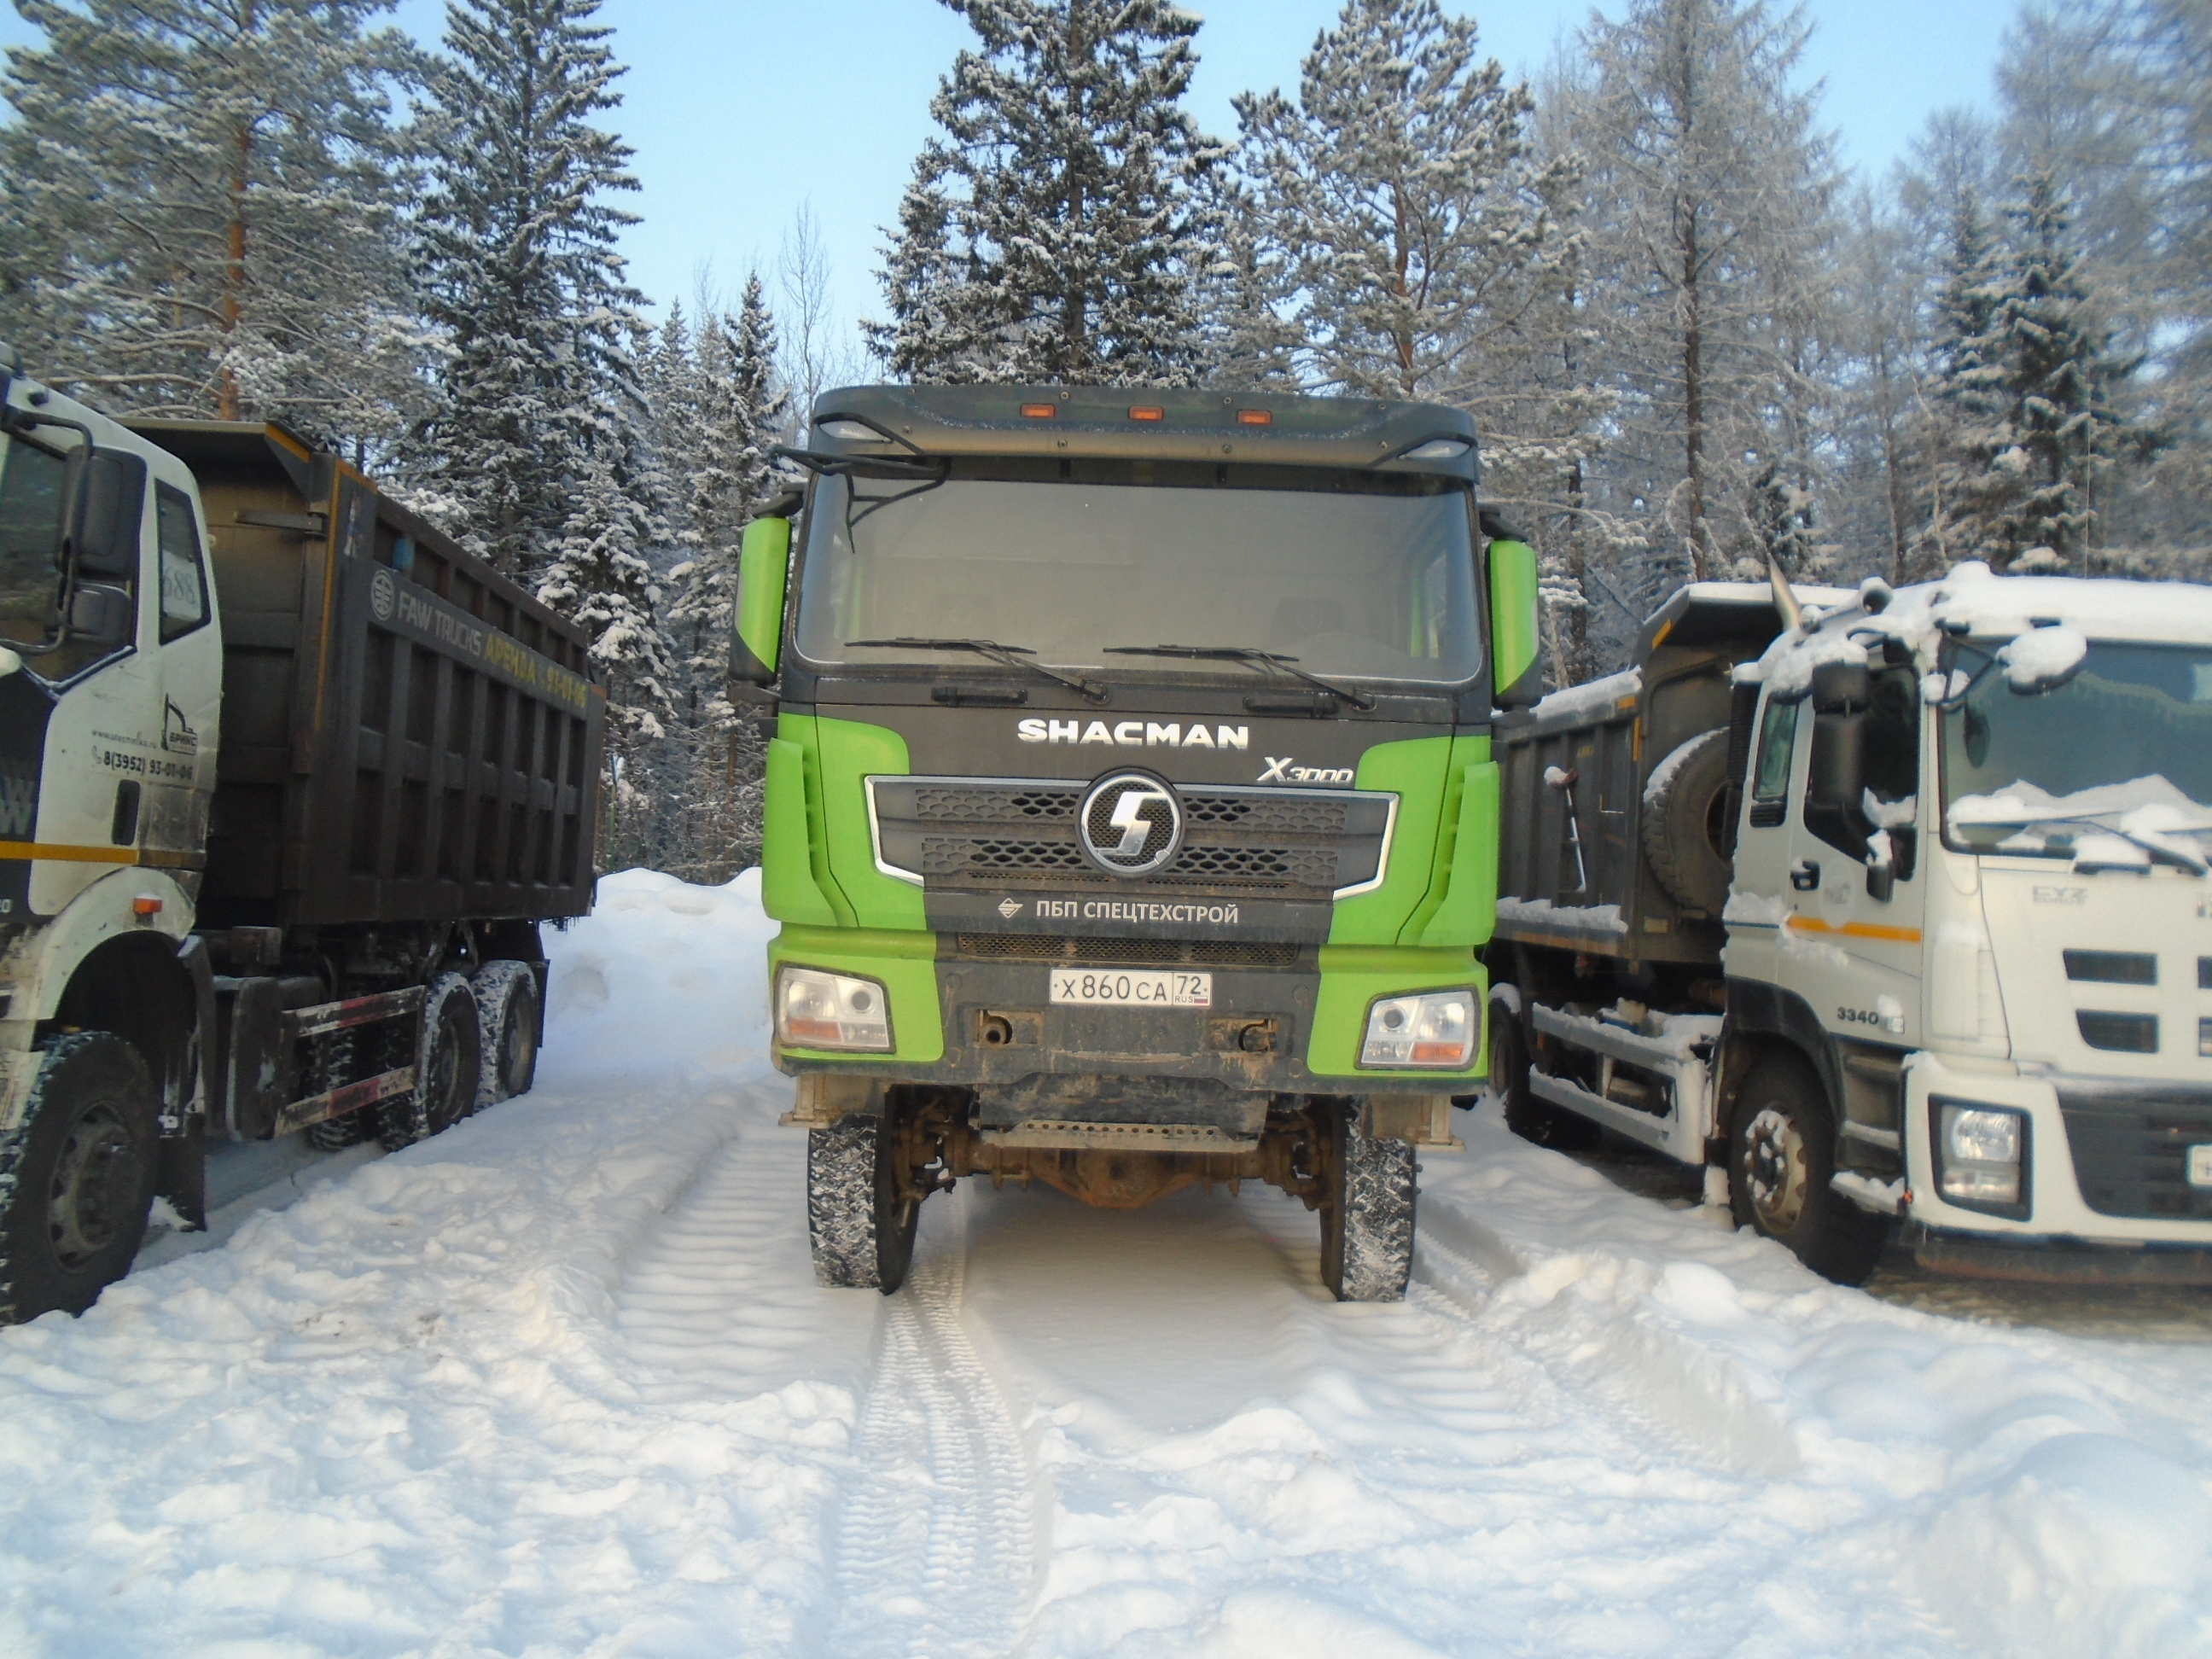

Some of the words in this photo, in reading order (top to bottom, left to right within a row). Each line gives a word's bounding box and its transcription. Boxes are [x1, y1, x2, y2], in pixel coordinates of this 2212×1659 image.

[397, 591, 433, 631] FAW
[1016, 719, 1249, 749] SHACMAN
[103, 750, 145, 776] 8(3952)
[1256, 755, 1354, 784] X3000
[1036, 899, 1078, 918] ПБП
[1084, 901, 1238, 923] СПЕЦТЕХСТРОЙ
[1177, 975, 1202, 995] 72
[1174, 995, 1194, 1004] RUS
[1837, 1006, 1879, 1025] 3340
